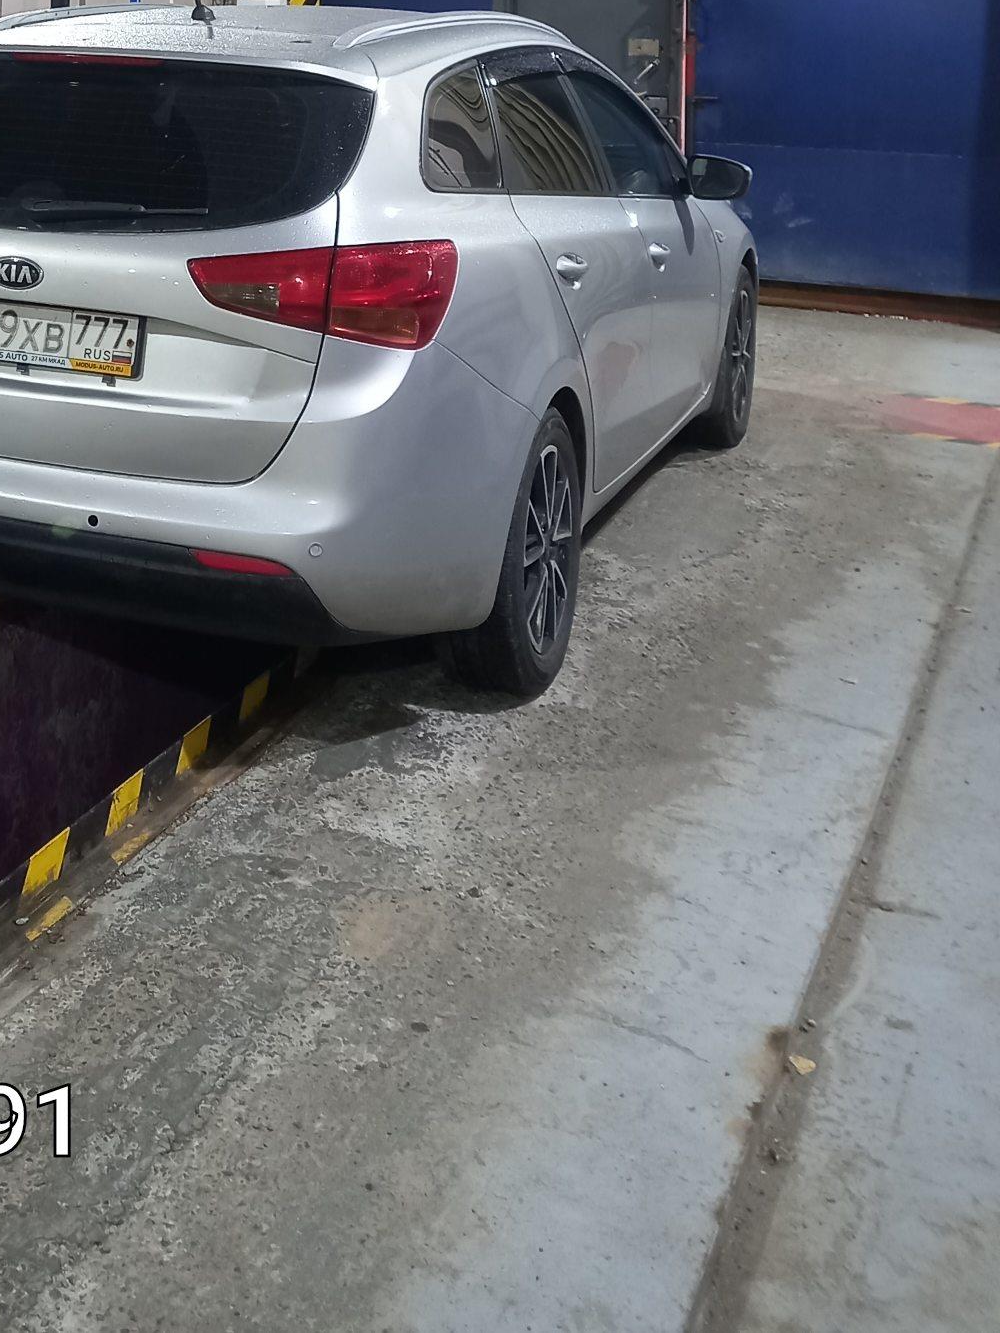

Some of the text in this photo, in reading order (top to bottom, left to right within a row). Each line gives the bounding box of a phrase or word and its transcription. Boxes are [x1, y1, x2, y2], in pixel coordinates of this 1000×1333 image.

[75, 314, 129, 349] 777
[5, 351, 28, 362] AUTO
[83, 348, 111, 361] RUS
